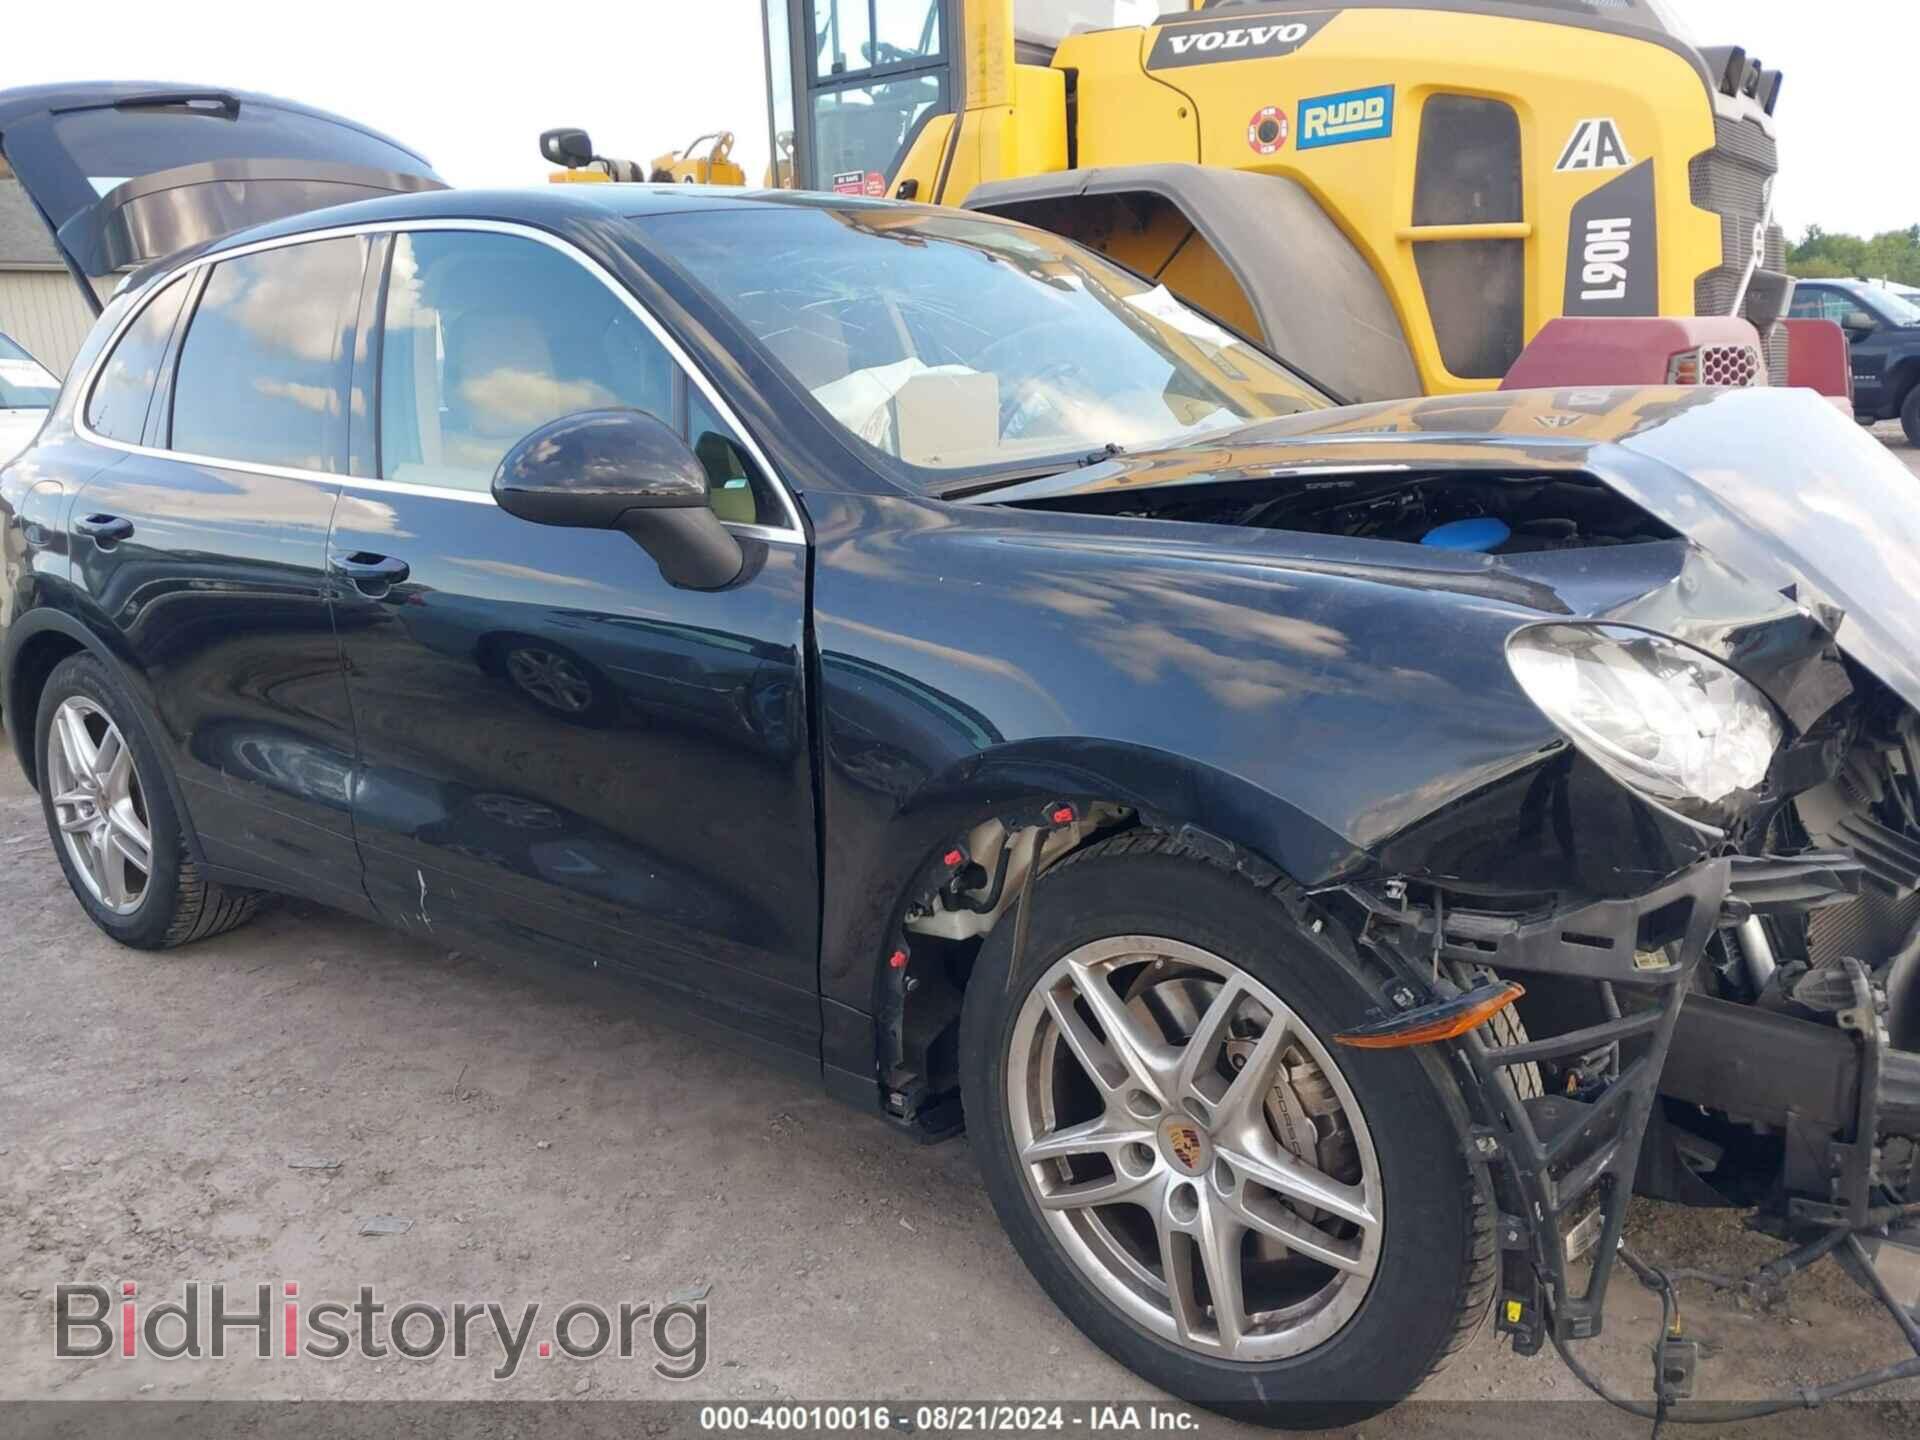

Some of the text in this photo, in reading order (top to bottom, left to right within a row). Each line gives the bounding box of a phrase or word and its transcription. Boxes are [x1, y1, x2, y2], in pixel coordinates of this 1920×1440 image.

[1168, 23, 1308, 54] VOLVO
[1304, 97, 1385, 139] RUDD
[1580, 217, 1632, 300] L90H
